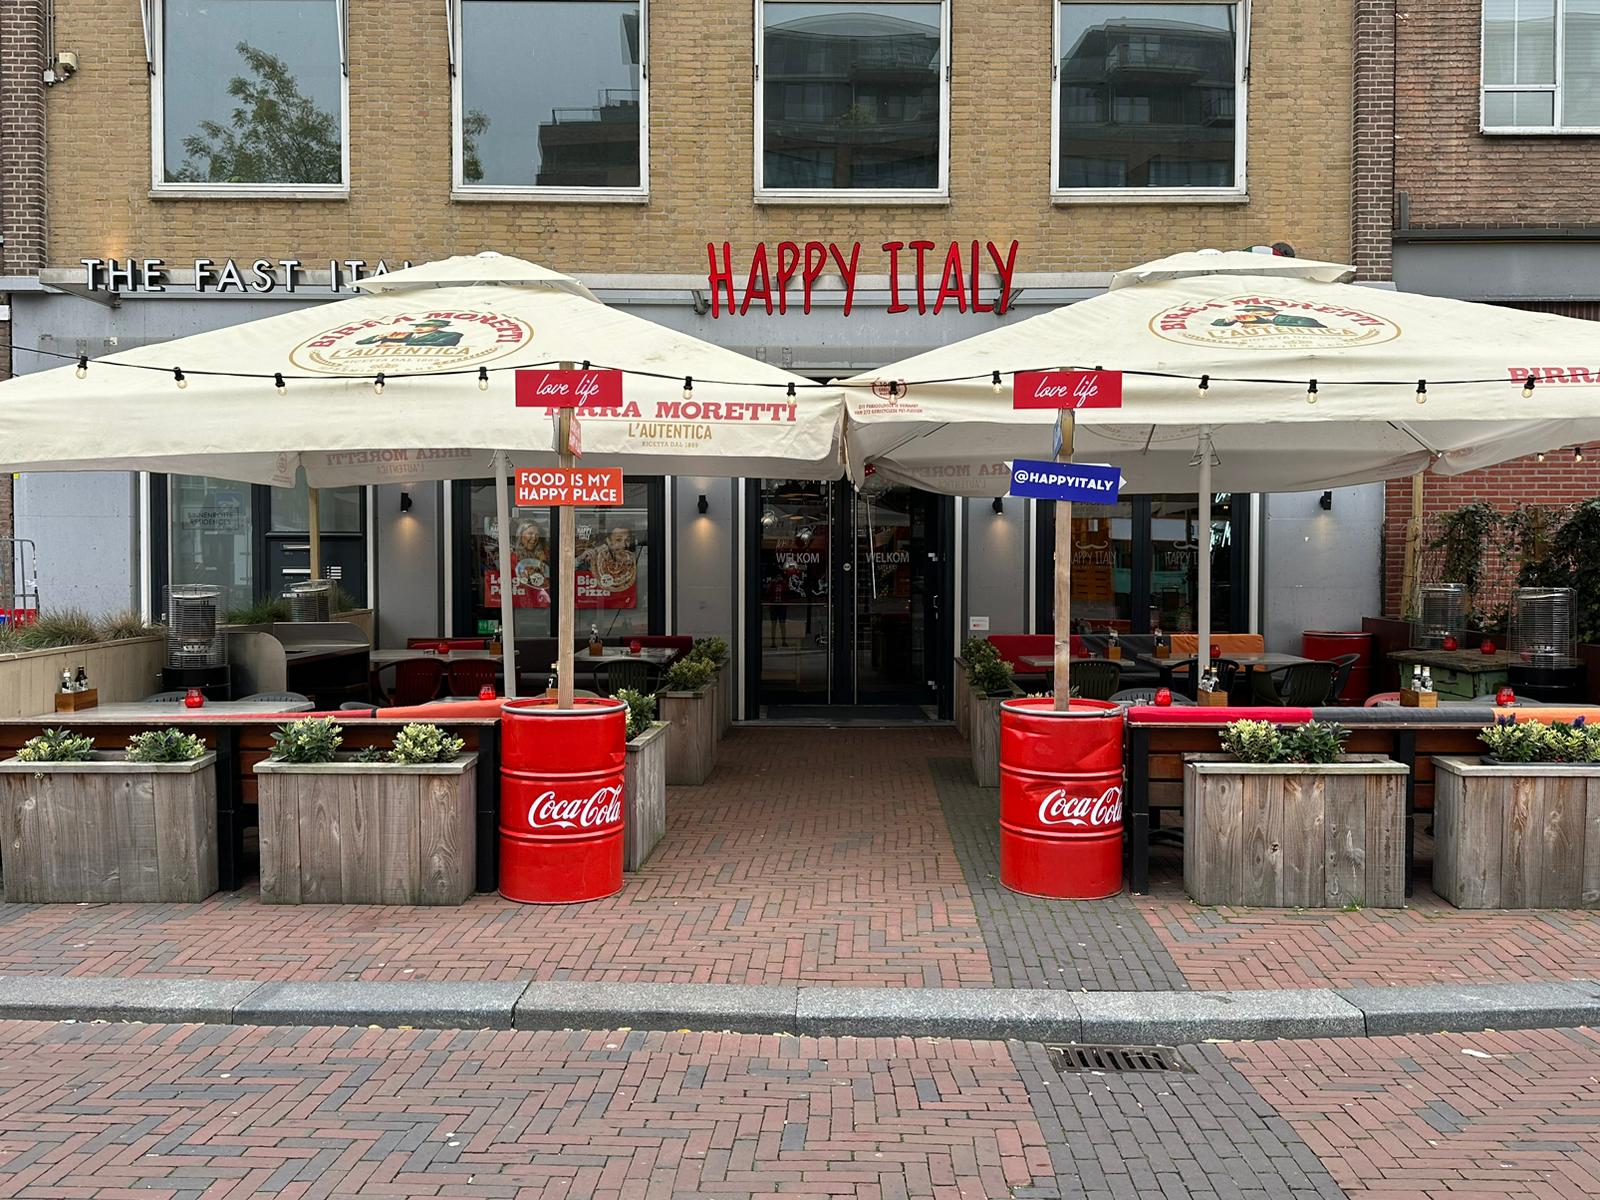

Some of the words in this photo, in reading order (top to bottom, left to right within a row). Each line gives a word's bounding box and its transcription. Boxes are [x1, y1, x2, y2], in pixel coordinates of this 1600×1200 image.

[81, 258, 165, 292] THE
[194, 258, 301, 292] FAST
[329, 258, 413, 293] ITA
[707, 241, 861, 319] HAPPY
[882, 239, 1019, 316] ITALY
[1207, 325, 1360, 339] L'AUTENTICA
[329, 346, 473, 359] L'AUTENTICA
[1507, 366, 1600, 385] BIRR
[536, 373, 570, 395] love
[575, 373, 600, 407] life
[1034, 376, 1067, 398] love
[1073, 375, 1099, 408] life
[656, 401, 797, 422] MORETTI
[628, 422, 713, 440] L'AUTENTICA
[521, 472, 566, 486] FOOD
[571, 473, 583, 486] IS
[588, 474, 611, 487] MY
[1014, 469, 1114, 492] @HAPPYITALY
[519, 487, 568, 501] HAPPY
[573, 488, 617, 502] PLACE
[776, 552, 820, 564] WELKOM
[866, 552, 910, 564] WELKOM
[1071, 551, 1093, 565] APPY
[577, 575, 598, 588] Big
[577, 586, 611, 597] Pizza
[527, 783, 623, 829] Coca-Cola
